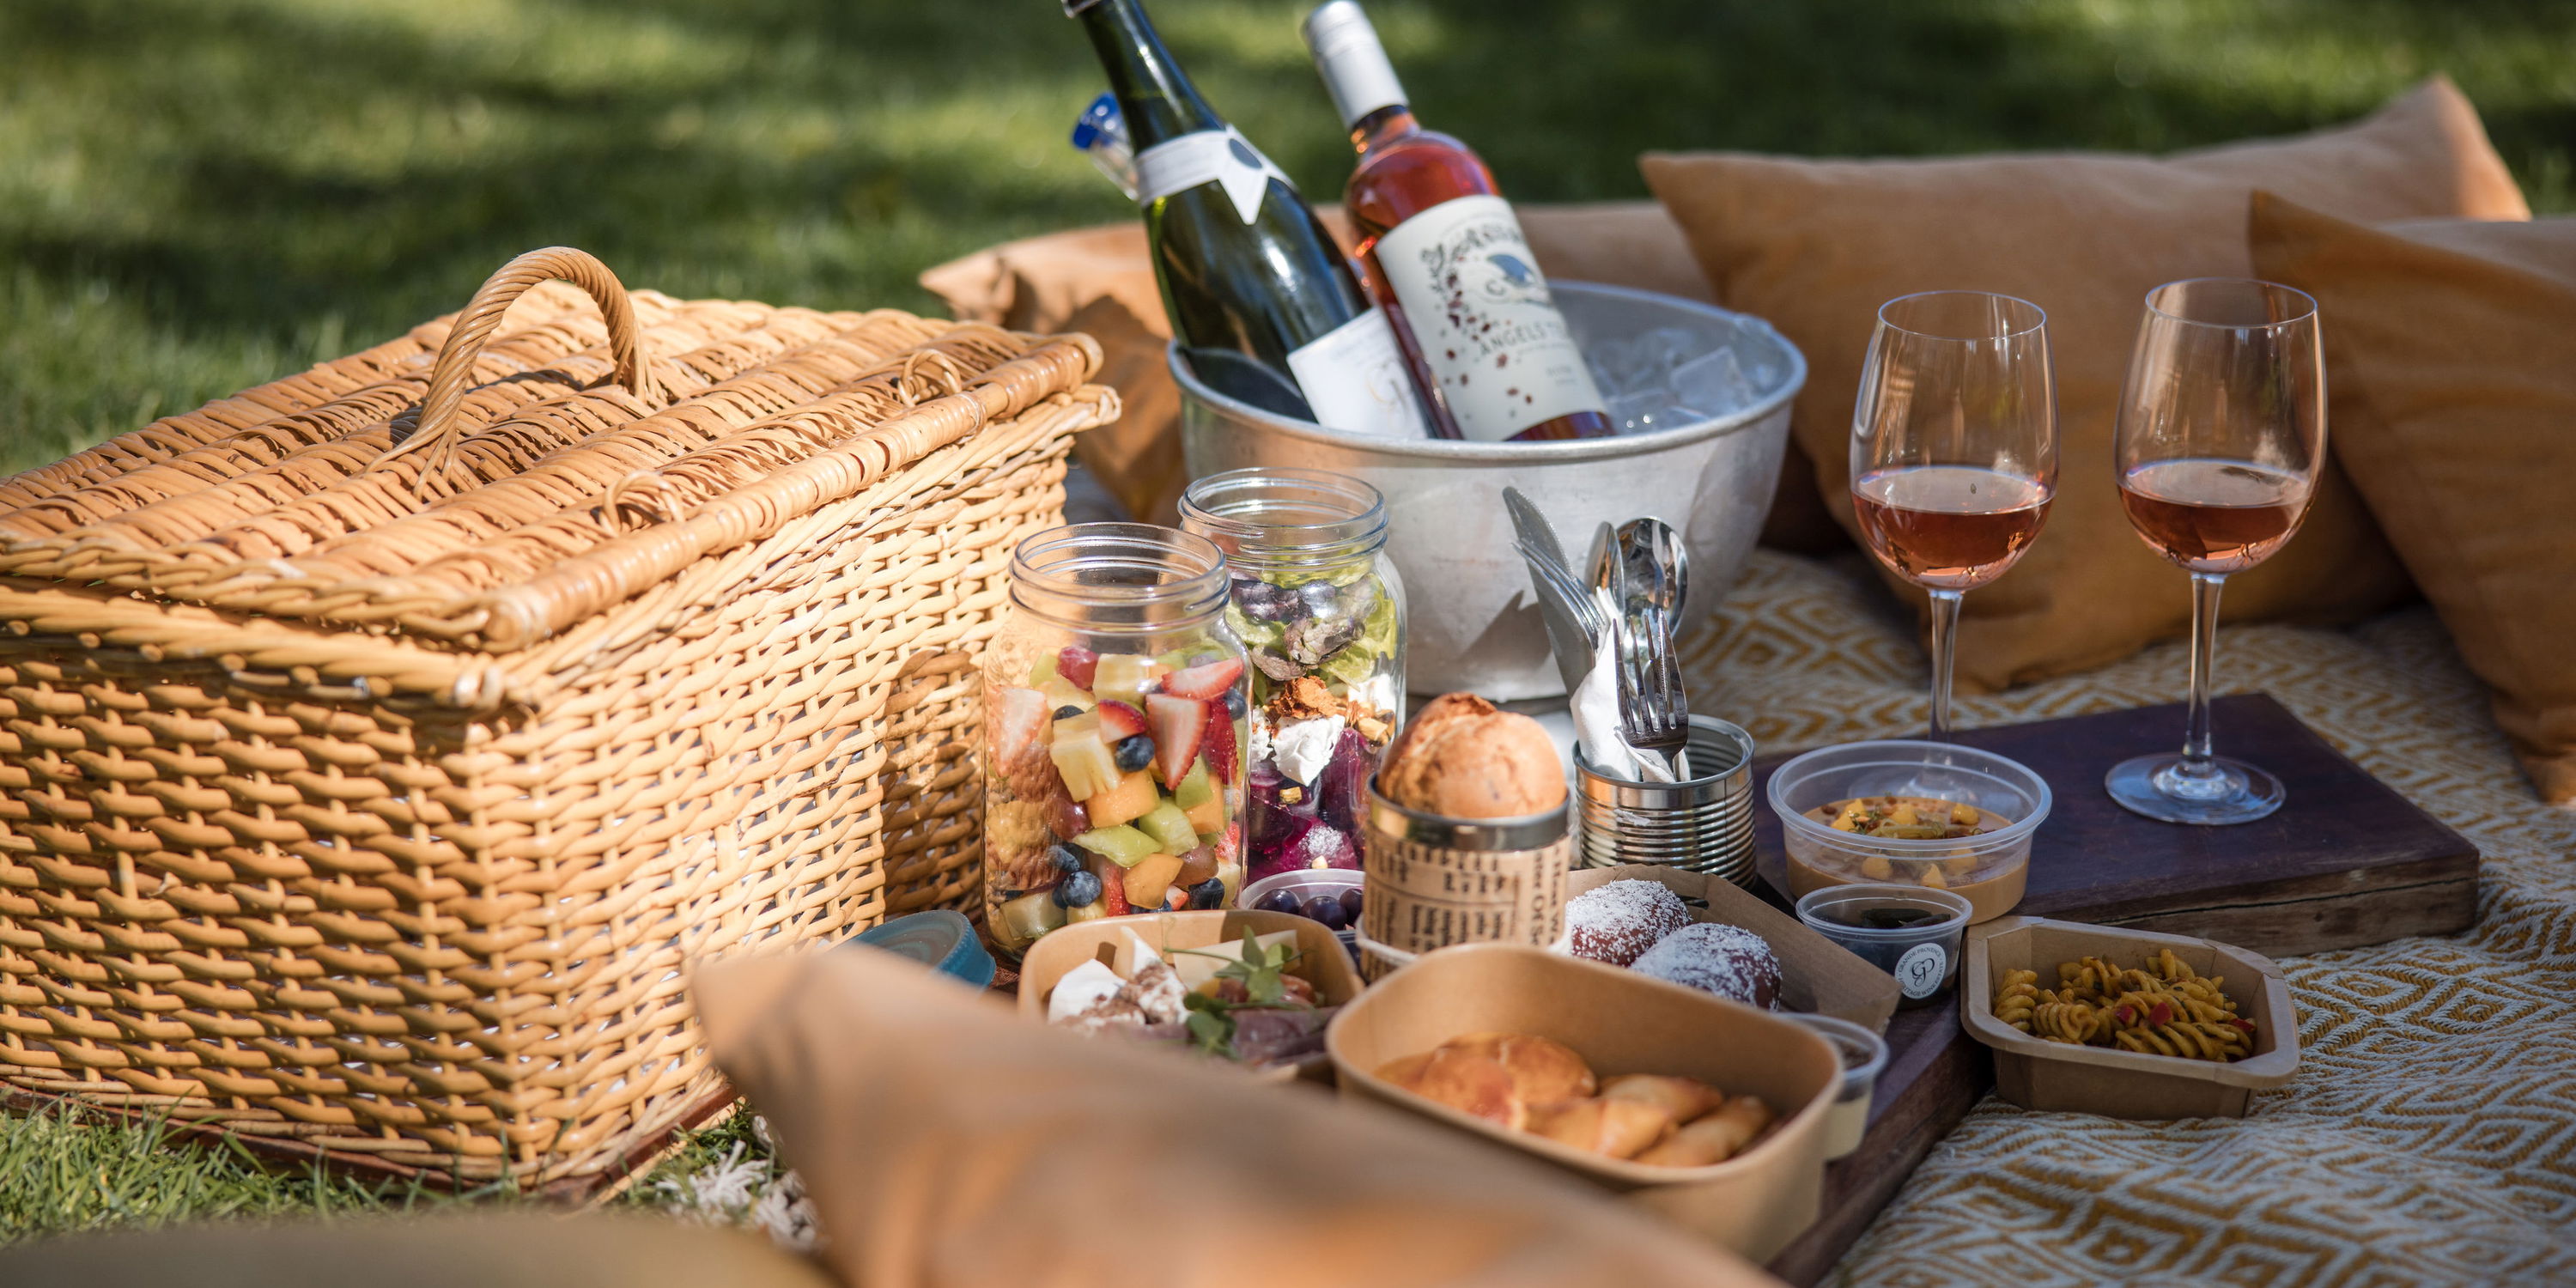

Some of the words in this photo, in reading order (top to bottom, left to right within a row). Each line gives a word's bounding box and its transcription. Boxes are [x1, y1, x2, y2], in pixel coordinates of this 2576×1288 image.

[1479, 322, 1546, 355] ANGELS
[1899, 951, 1916, 972] GRANDE
[1921, 983, 1936, 996] WINE
[1935, 963, 1944, 985] ESTATE
